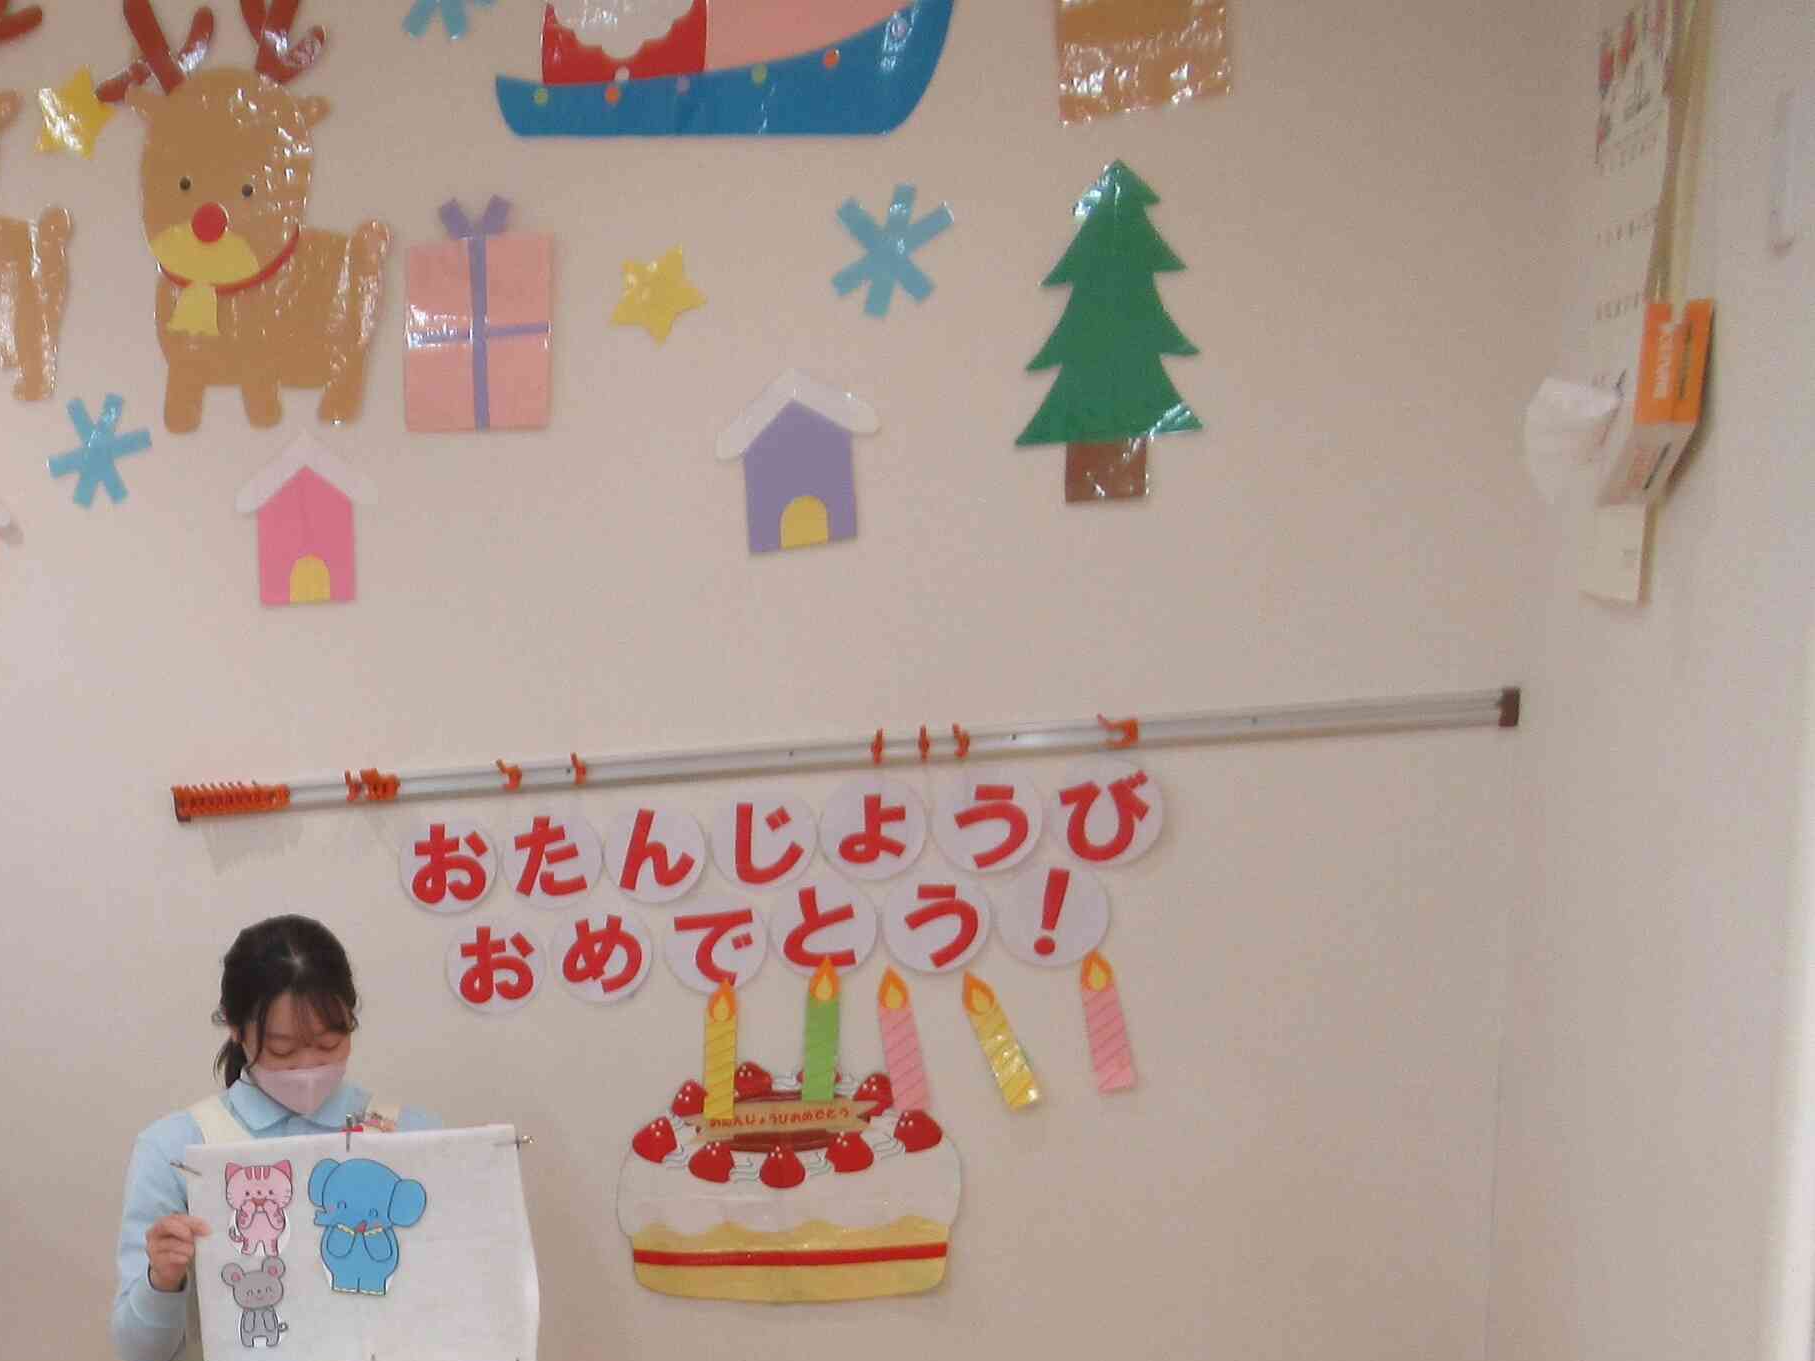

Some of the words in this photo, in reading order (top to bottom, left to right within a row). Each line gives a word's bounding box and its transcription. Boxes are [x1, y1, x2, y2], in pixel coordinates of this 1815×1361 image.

[411, 770, 1149, 906] おたんじょうび
[459, 867, 1071, 1006] おめでとう！
